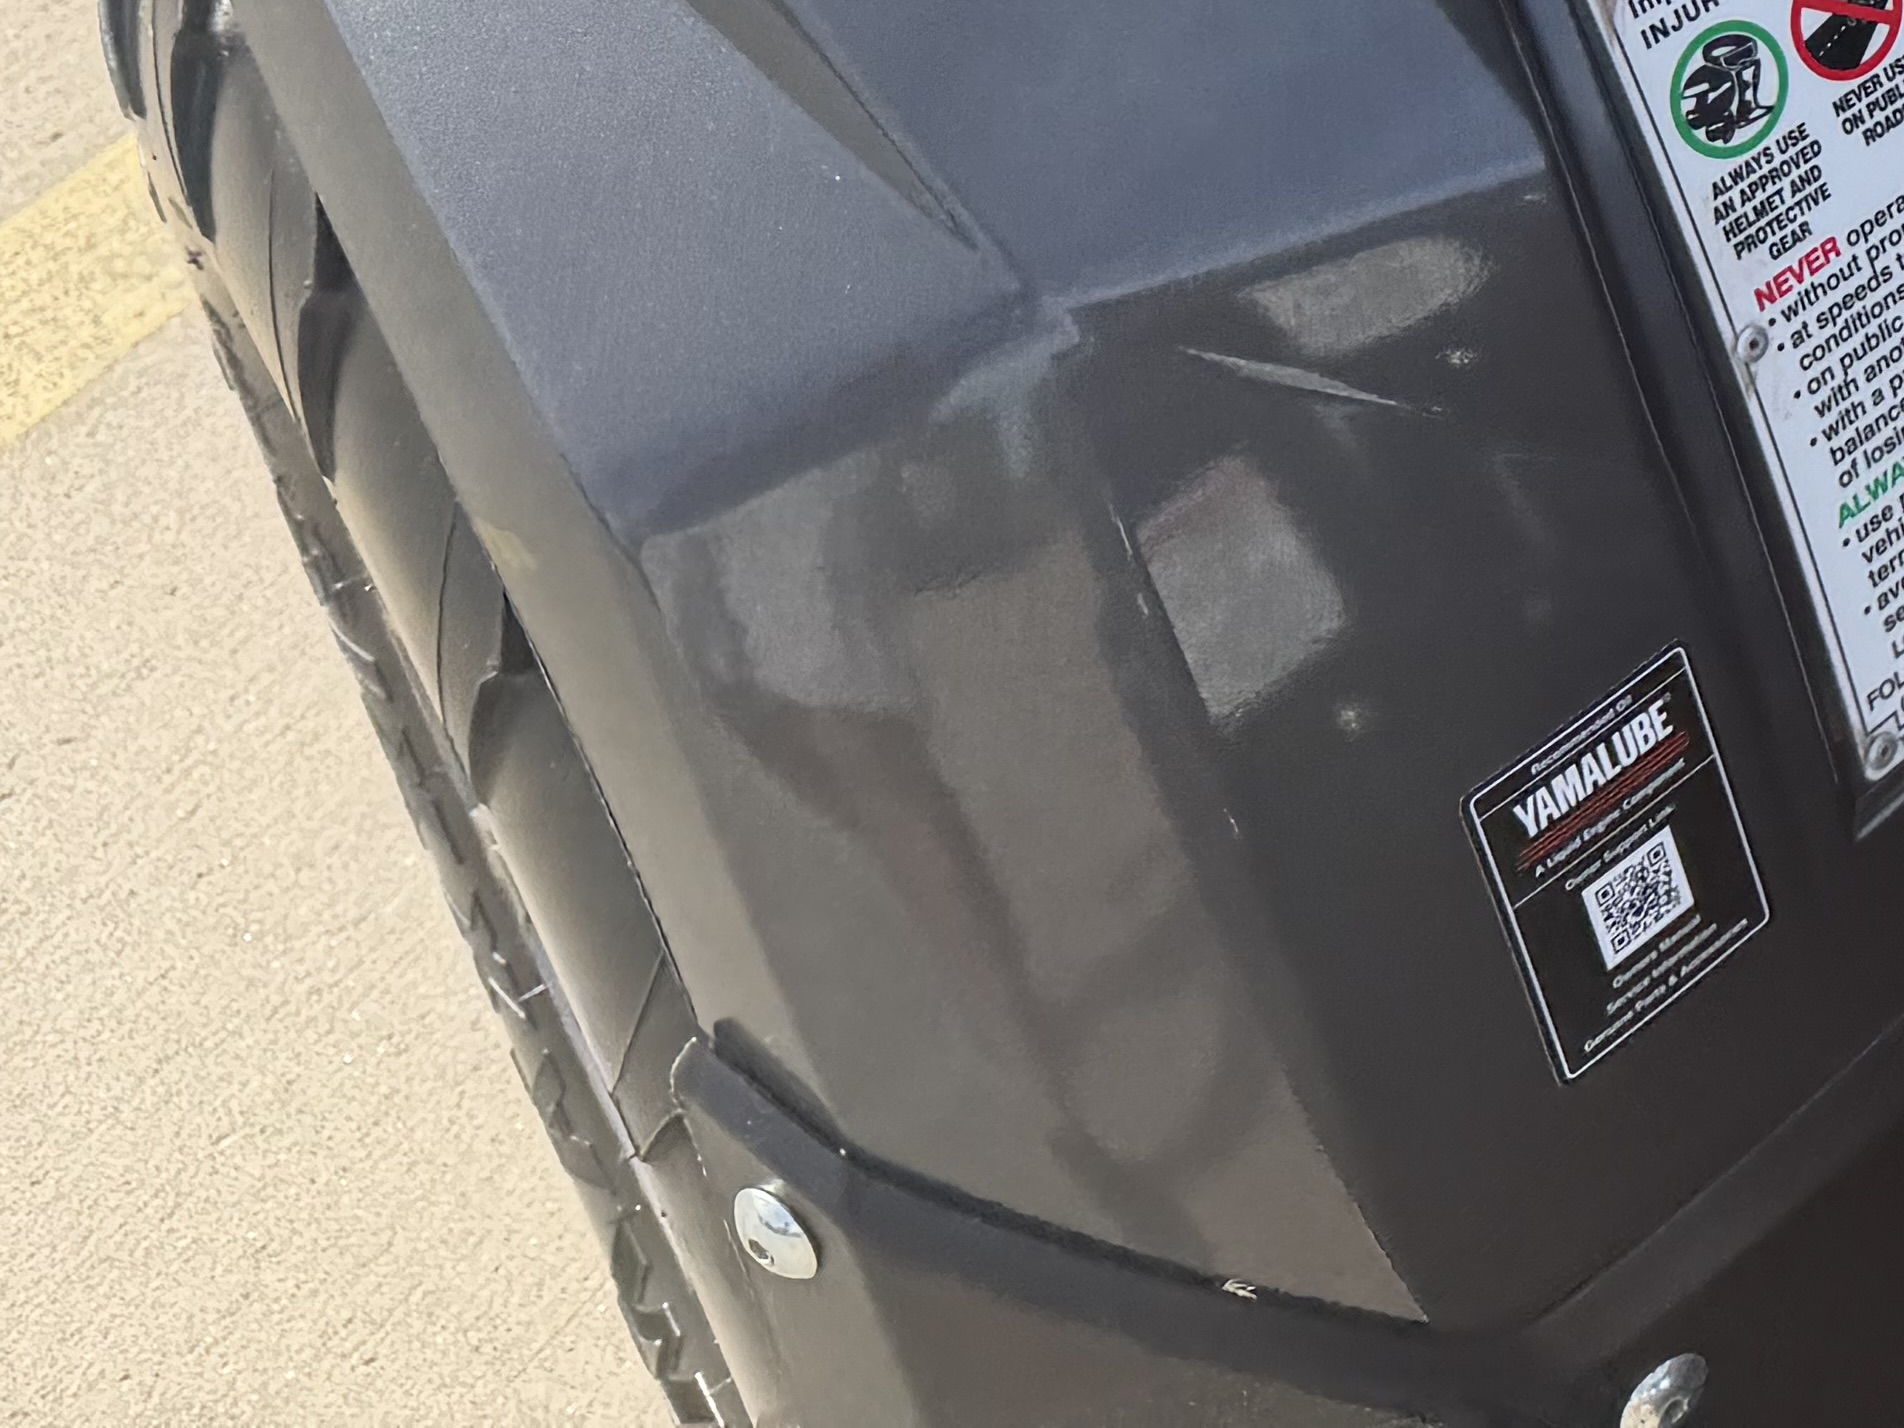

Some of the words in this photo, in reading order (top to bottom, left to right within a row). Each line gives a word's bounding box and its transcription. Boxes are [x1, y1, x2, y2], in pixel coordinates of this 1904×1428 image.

[1832, 73, 1884, 117] NEVER
[1842, 108, 1866, 135] ON
[1712, 146, 1774, 201] ALWAYS
[1775, 122, 1810, 155] USE
[1714, 196, 1737, 225] AN
[1739, 140, 1822, 208] APPROVED
[1722, 187, 1785, 243] HELMET
[1790, 165, 1822, 198] AND
[1733, 182, 1831, 260] PROTECTIVE
[1769, 221, 1812, 260] GEAR
[1754, 236, 1841, 312] NEVER
[1781, 254, 1862, 323] without
[1790, 321, 1813, 349] at
[1816, 265, 1893, 330] speeds
[1807, 366, 1835, 395] on
[1839, 315, 1904, 376] public
[1814, 371, 1859, 418] with
